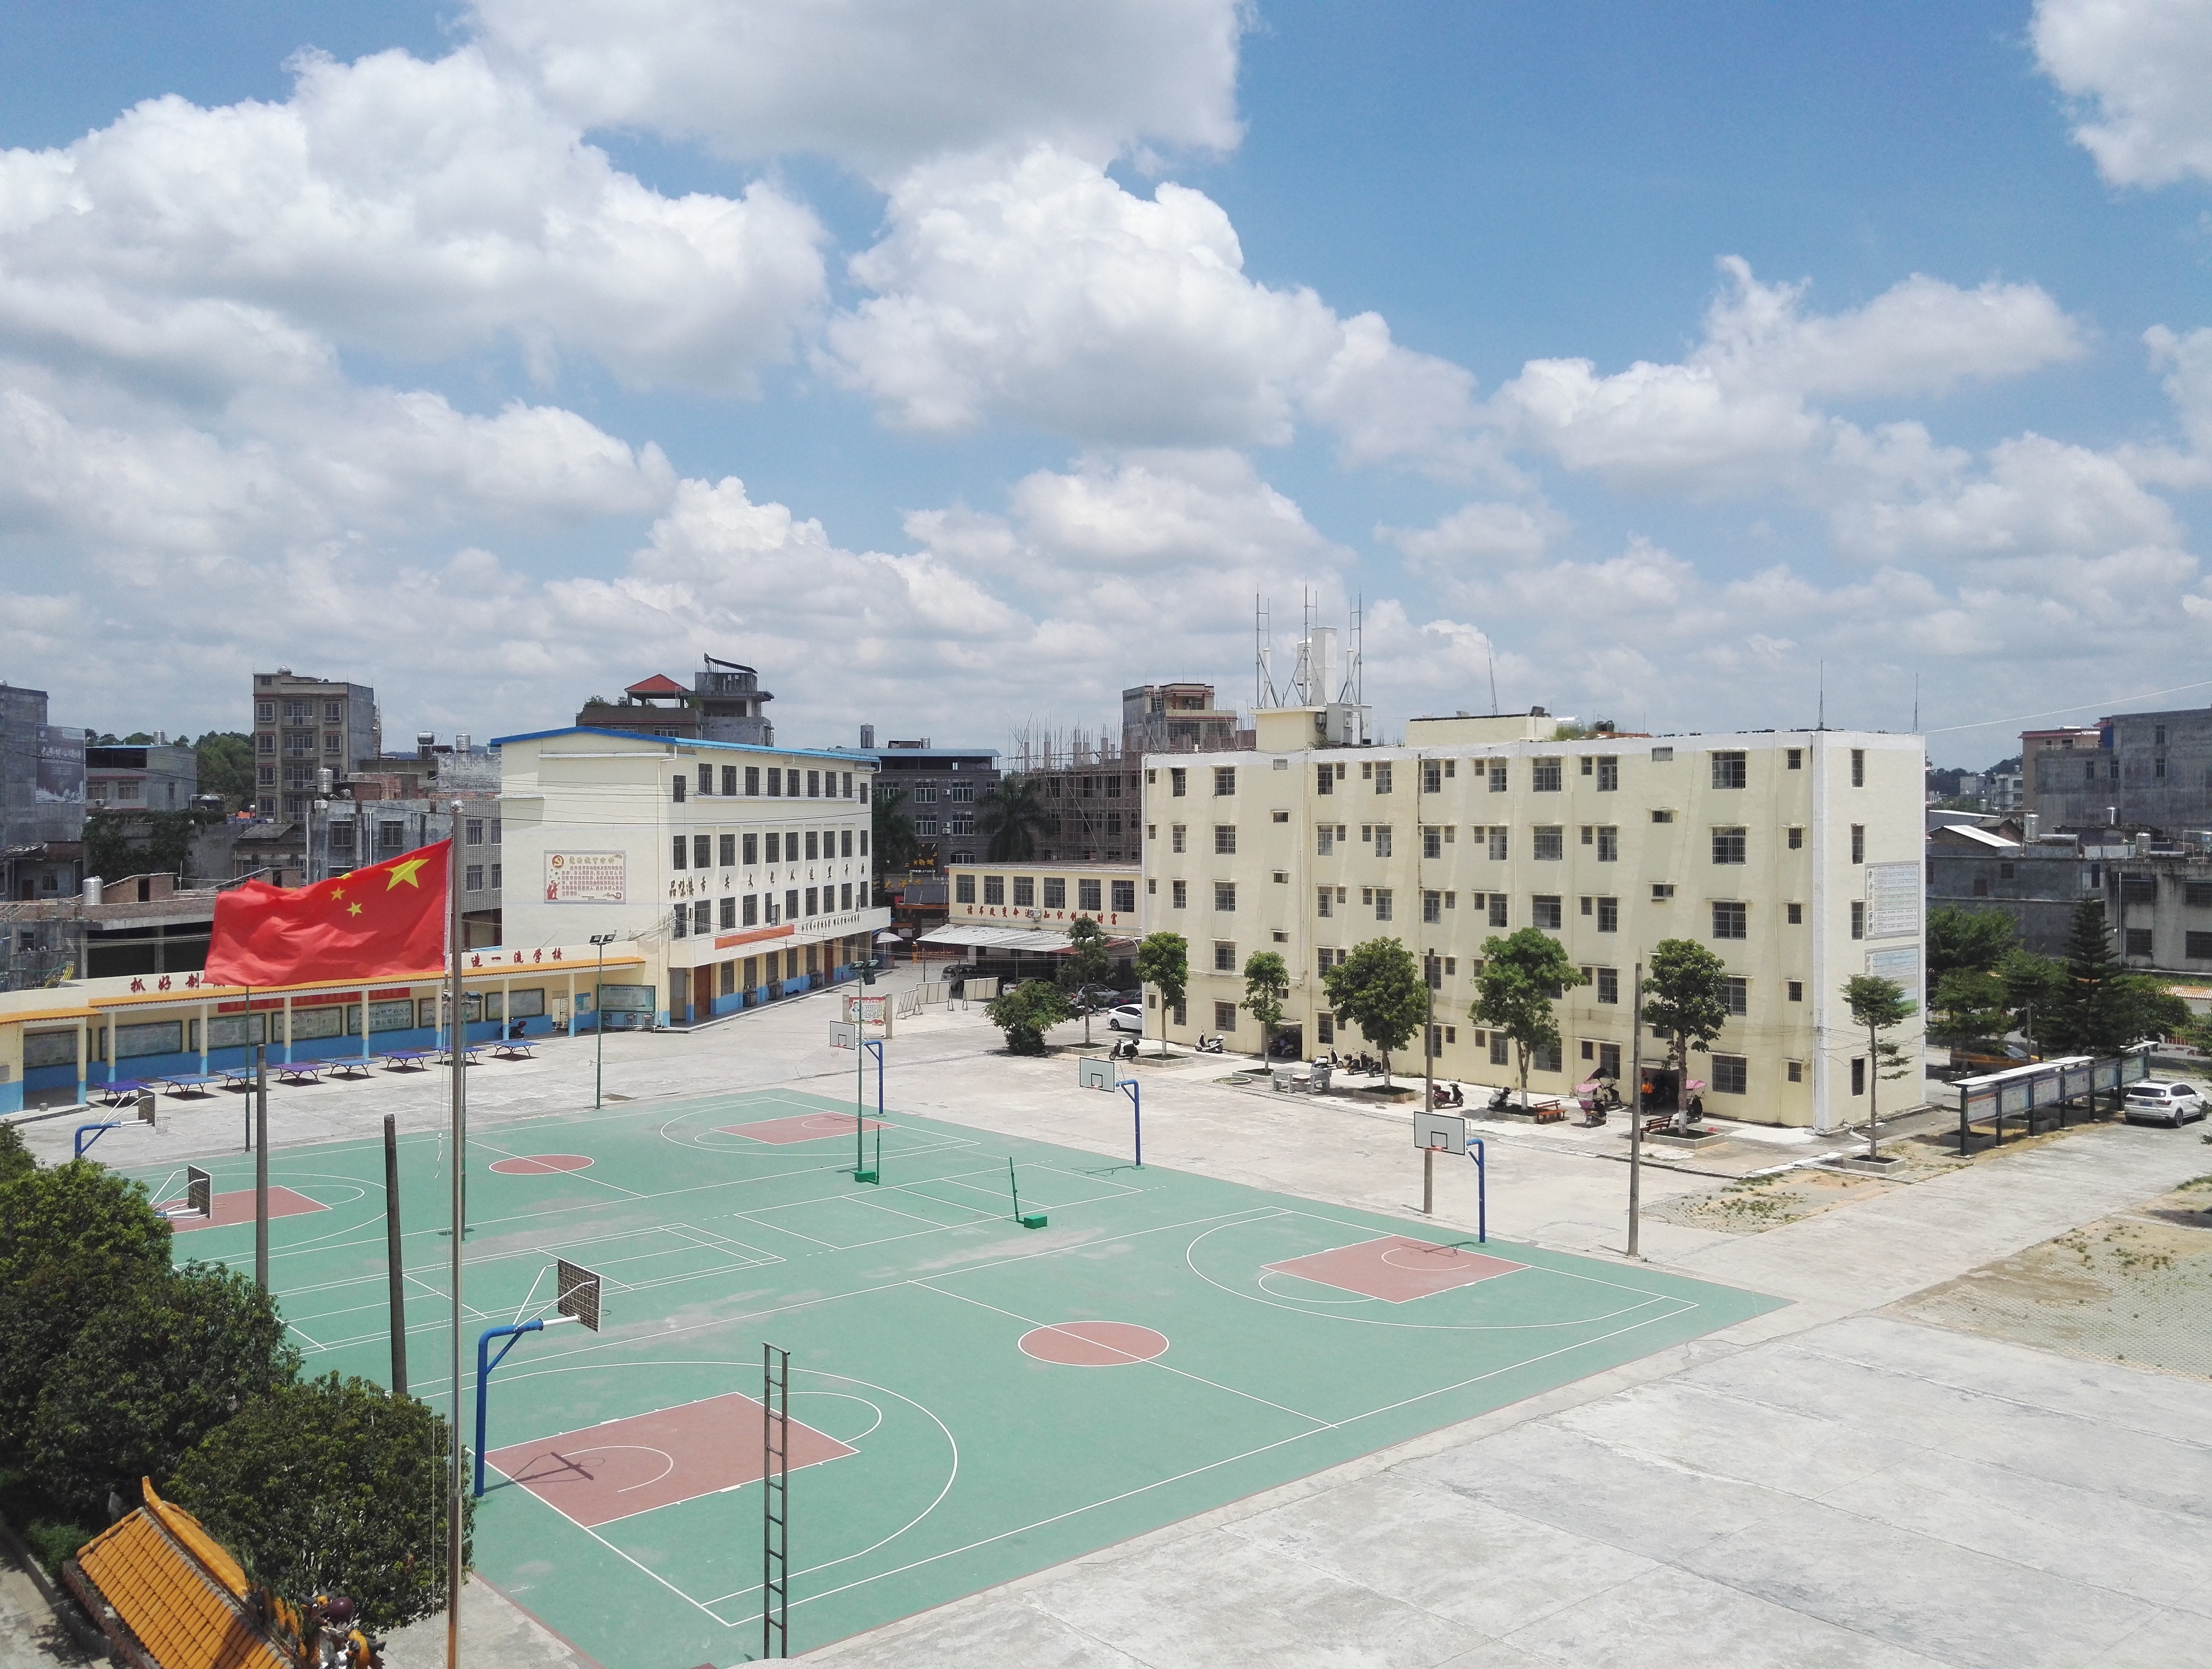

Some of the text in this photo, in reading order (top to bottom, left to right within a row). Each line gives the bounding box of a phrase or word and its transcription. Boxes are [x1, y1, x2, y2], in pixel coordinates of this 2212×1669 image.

[471, 947, 562, 967] 造一流学校
[130, 972, 225, 993] 抓好制
